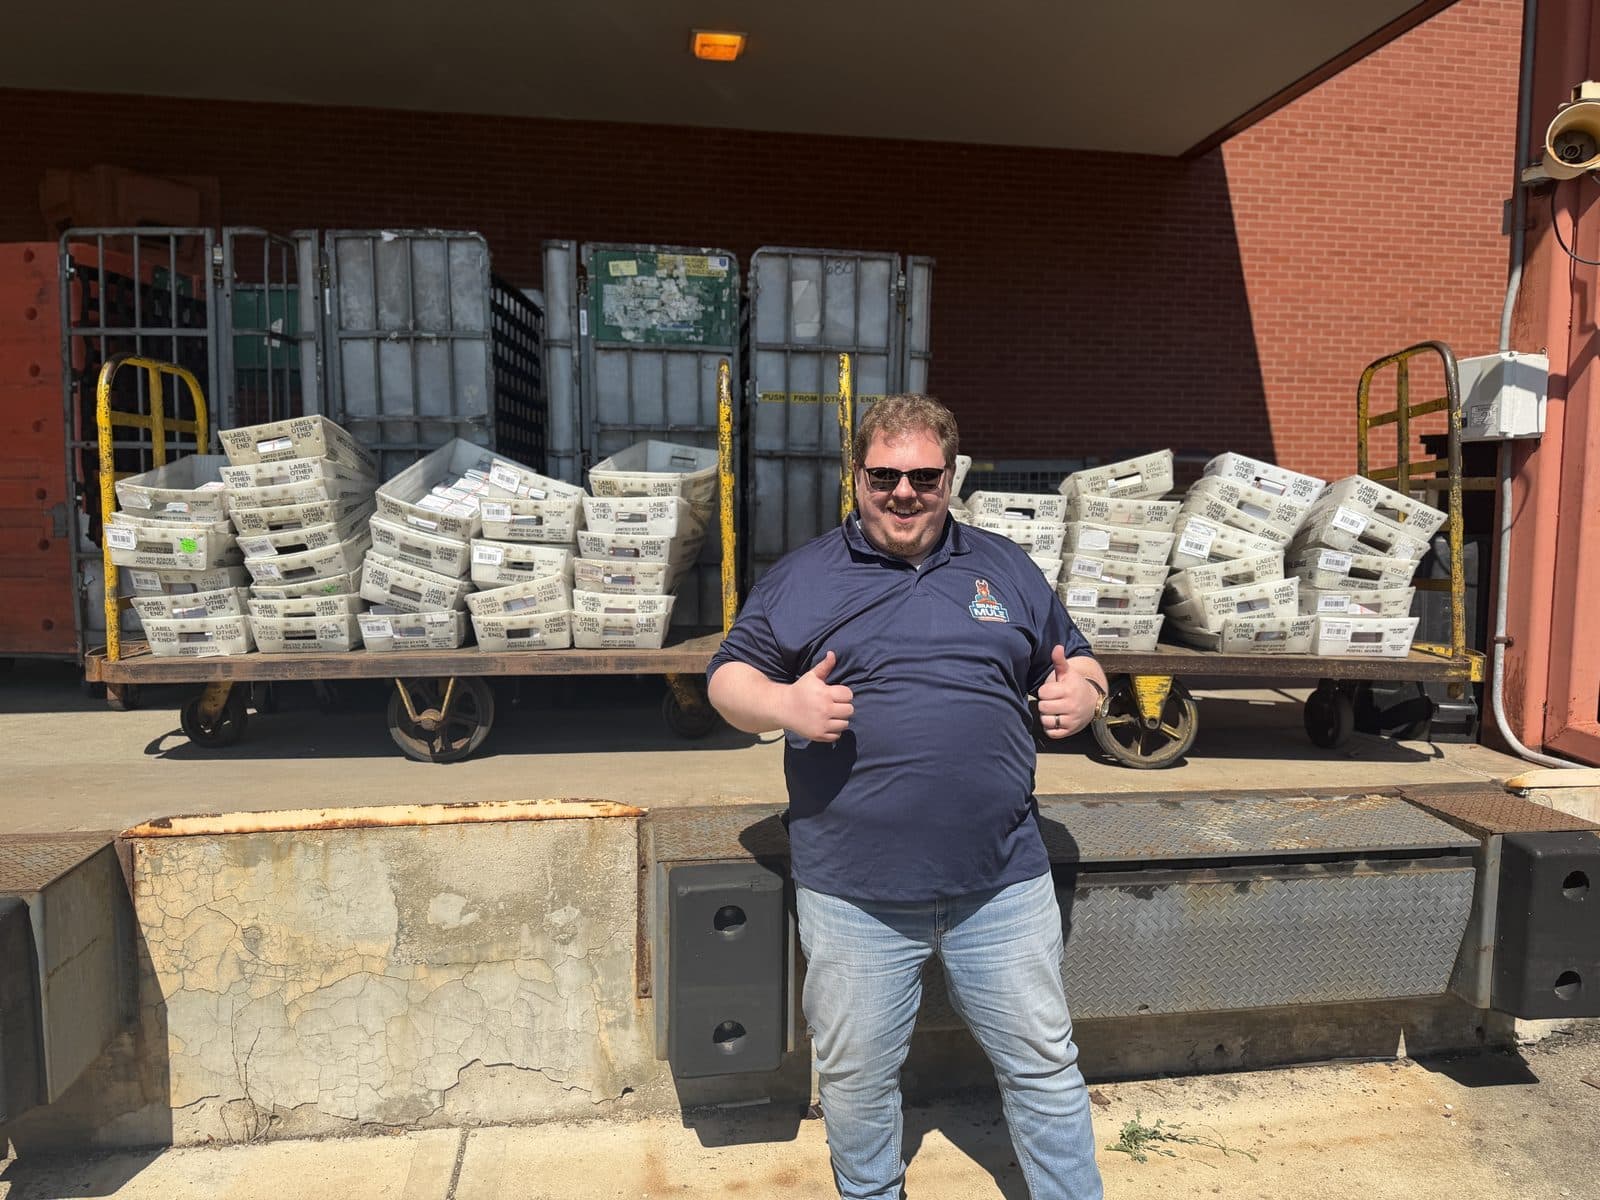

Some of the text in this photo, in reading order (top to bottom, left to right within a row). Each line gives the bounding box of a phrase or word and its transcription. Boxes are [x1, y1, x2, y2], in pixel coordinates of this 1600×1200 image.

[290, 420, 312, 428] LABEL
[291, 425, 314, 434] OTHER
[1236, 459, 1256, 469] LABEL
[290, 468, 314, 476] OTHER
[1233, 465, 1255, 475] OTHER
[229, 475, 251, 483] OTHER
[1294, 478, 1314, 487] LABEL
[1221, 484, 1240, 493] LABEL
[1291, 483, 1313, 493] OTHER
[1360, 484, 1379, 496] LABEL
[1218, 489, 1239, 499] OTHER
[1356, 490, 1378, 501] OTHER
[1358, 496, 1371, 505] END
[1209, 501, 1228, 513] LABEL
[1278, 503, 1298, 511] LABEL
[303, 511, 325, 519] OTHER
[1206, 507, 1226, 518] OTHER
[1206, 512, 1219, 520] END
[1276, 508, 1297, 518] OTHER
[1416, 509, 1435, 520] LABEL
[1413, 514, 1433, 526] OTHER
[1413, 521, 1426, 529] END
[305, 531, 326, 539] LABEL
[1262, 528, 1281, 539] LABEL
[306, 536, 328, 545] OTHER
[436, 550, 457, 558] OTHER
[1256, 557, 1275, 565] LABEL
[370, 568, 389, 577] LABEL
[369, 574, 389, 583] OTHER
[537, 583, 557, 591] LABEL
[538, 589, 560, 597] OTHER
[1274, 591, 1295, 599] OTHER
[205, 599, 228, 607] OTHER
[477, 602, 500, 610] OTHER
[974, 608, 1005, 618] MULE
